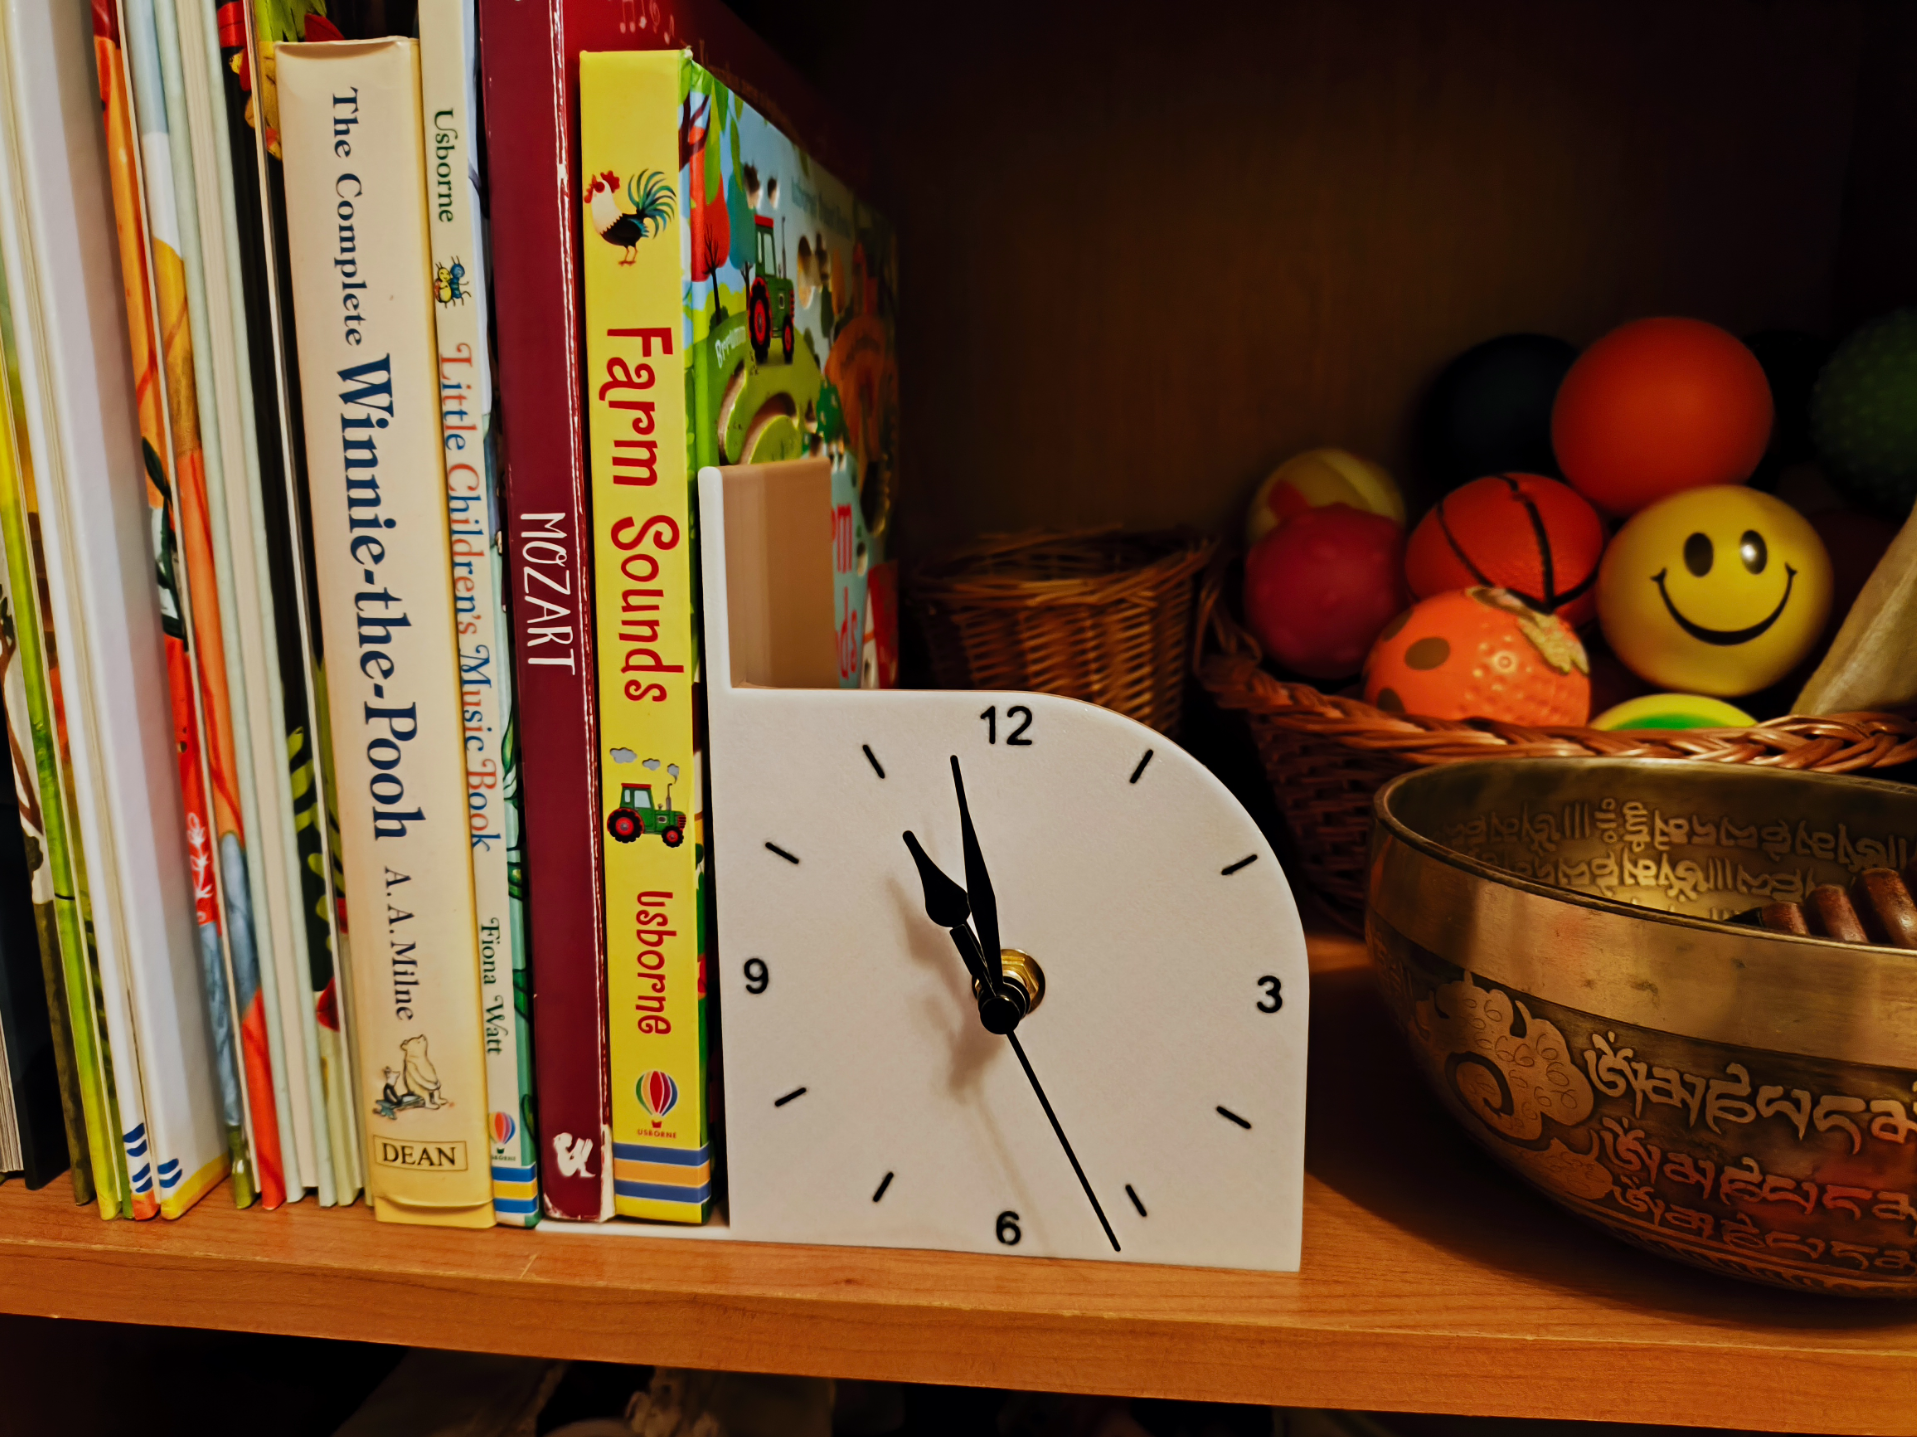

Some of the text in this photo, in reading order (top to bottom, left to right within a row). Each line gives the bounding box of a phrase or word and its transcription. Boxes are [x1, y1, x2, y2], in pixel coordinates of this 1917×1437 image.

[434, 109, 458, 223] Usborne
[332, 86, 426, 840] The Complete Winnie-the-Pooh
[599, 327, 686, 703] Farm Sounds
[440, 342, 502, 852] Little Children's Music Book
[520, 511, 576, 676] MOZART
[980, 705, 1033, 745] 12
[480, 917, 509, 1055] Fiona Watt
[635, 891, 678, 1036] Usborne
[743, 957, 770, 995] 9
[1256, 975, 1284, 1014] 3
[382, 1142, 456, 1167] DEAN
[636, 1128, 677, 1140] USBORNE
[995, 1210, 1022, 1246] 6
